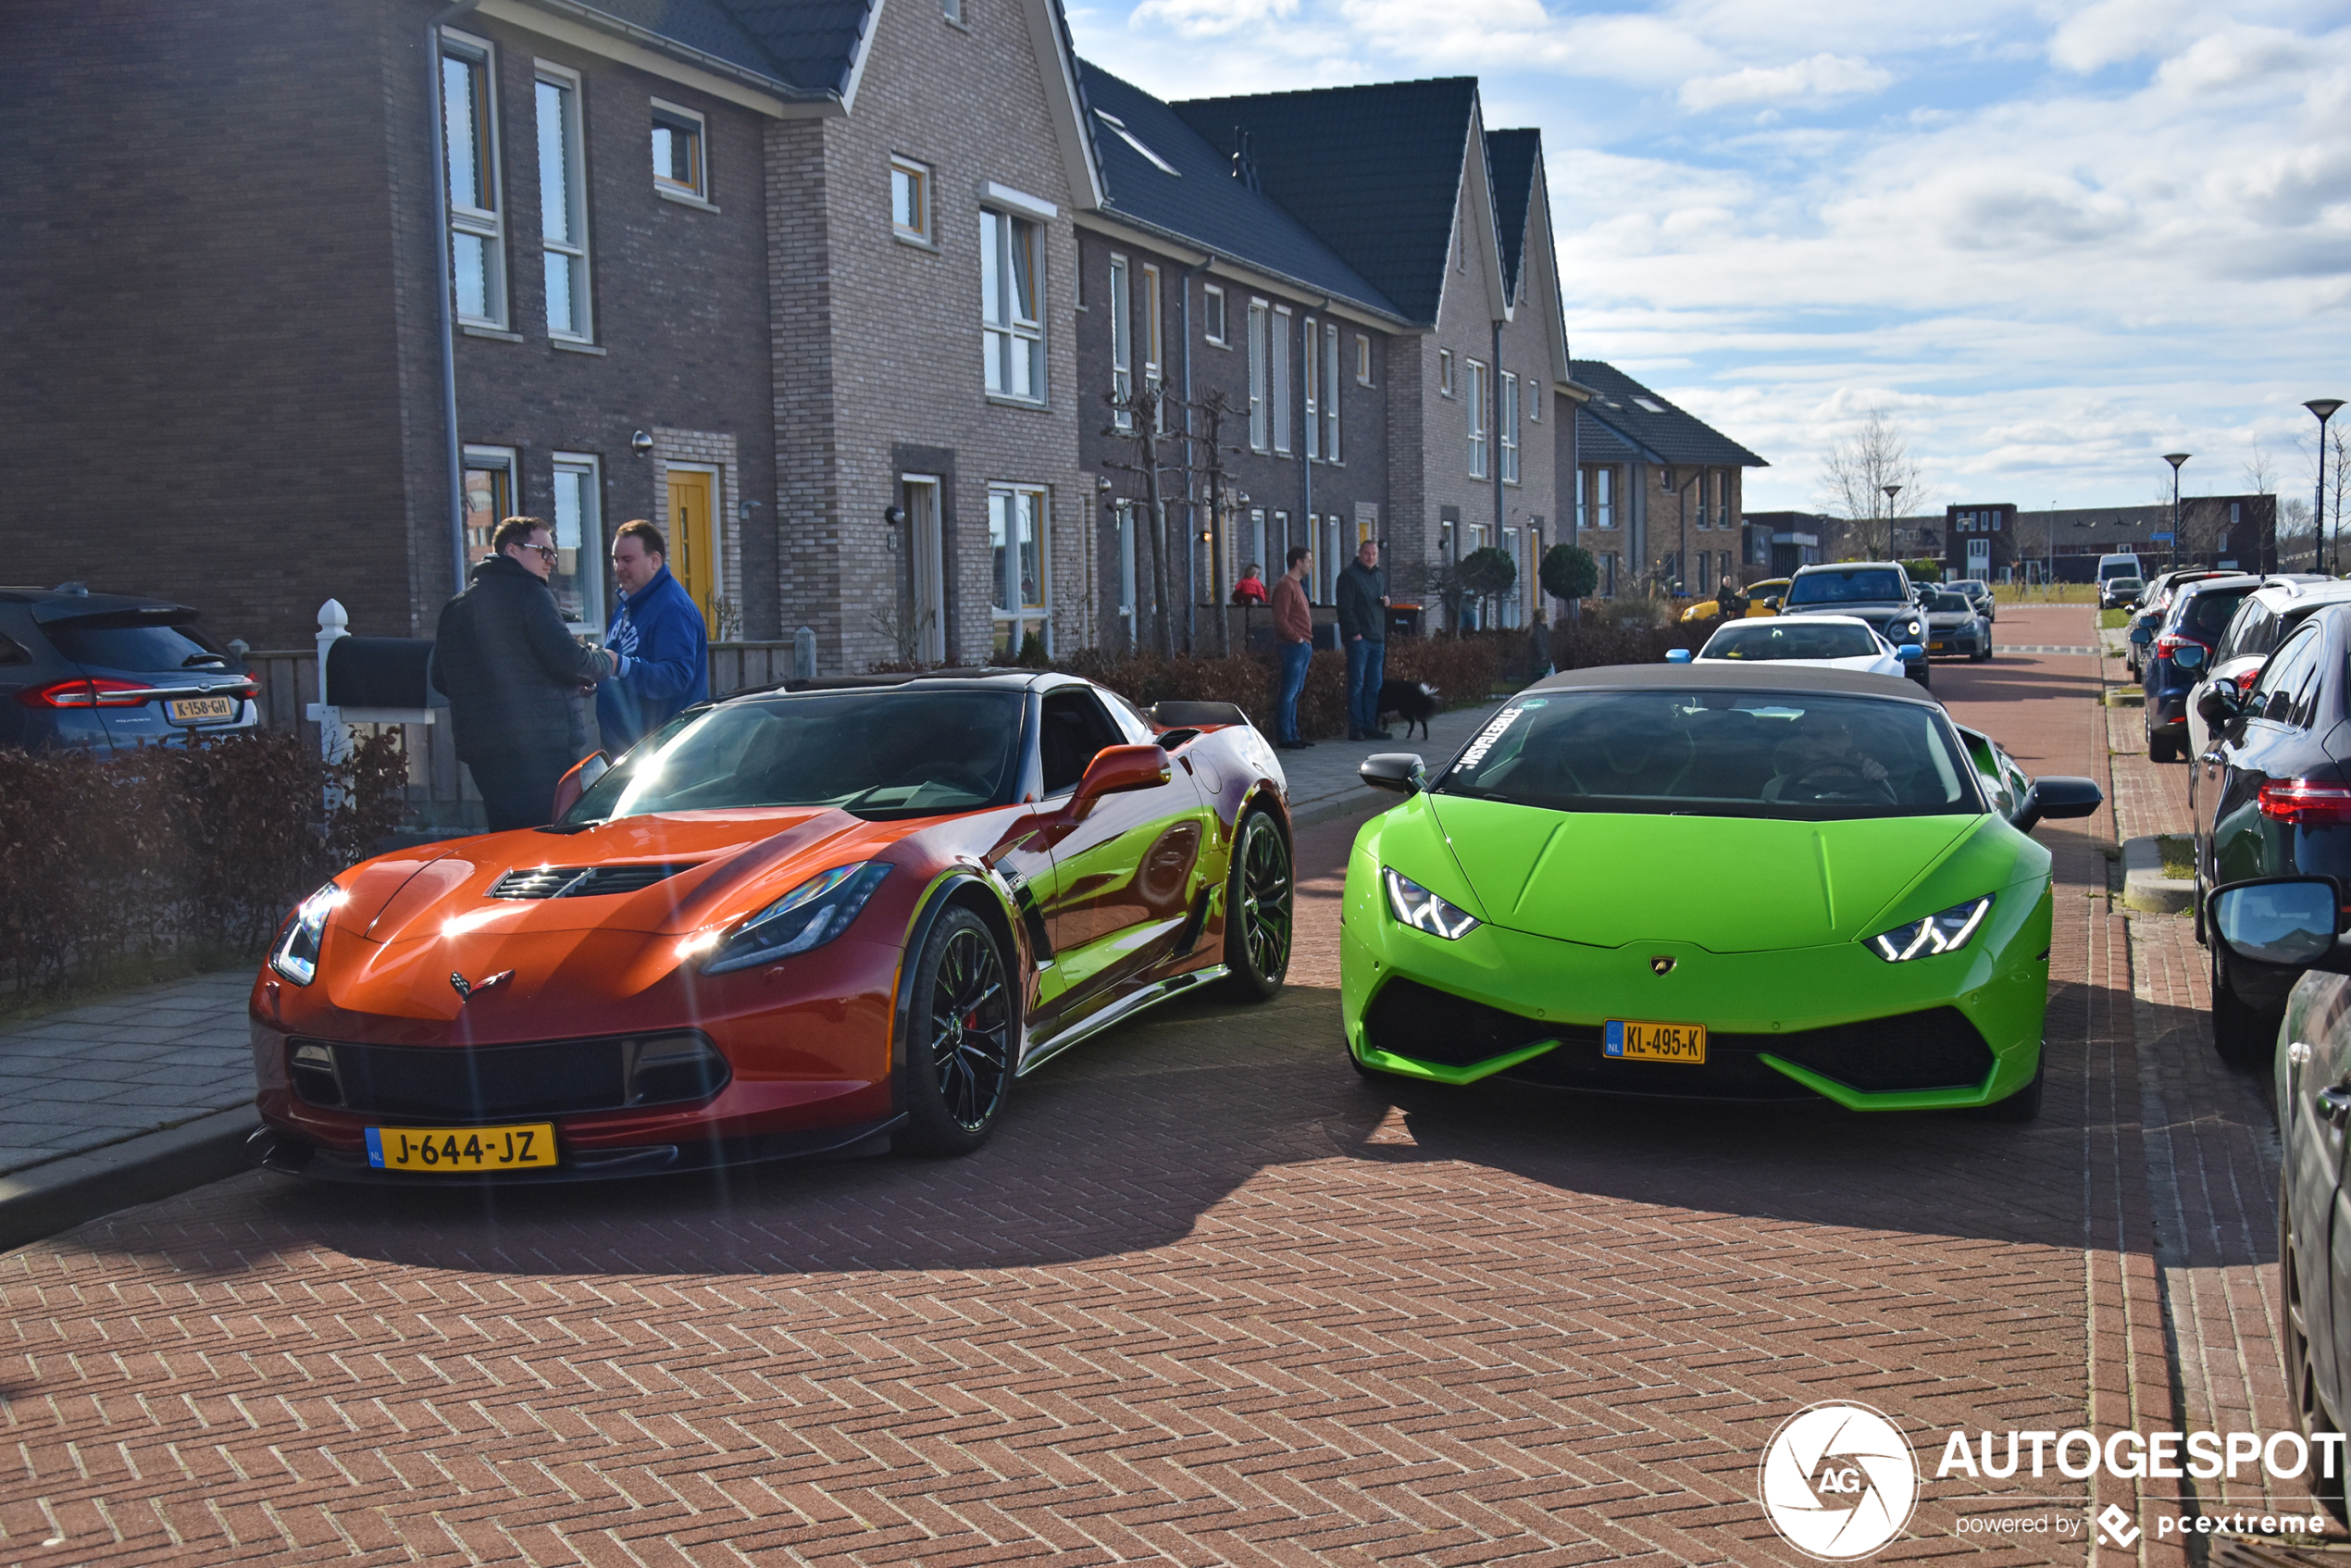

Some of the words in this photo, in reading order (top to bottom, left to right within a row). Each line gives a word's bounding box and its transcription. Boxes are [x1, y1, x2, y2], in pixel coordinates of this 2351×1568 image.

[176, 699, 228, 716] K-158-GH
[1608, 1043, 1620, 1053] NL
[1626, 1026, 1698, 1056] KL-495-K
[370, 1151, 382, 1162] NL
[396, 1131, 539, 1165] J-644-JZ
